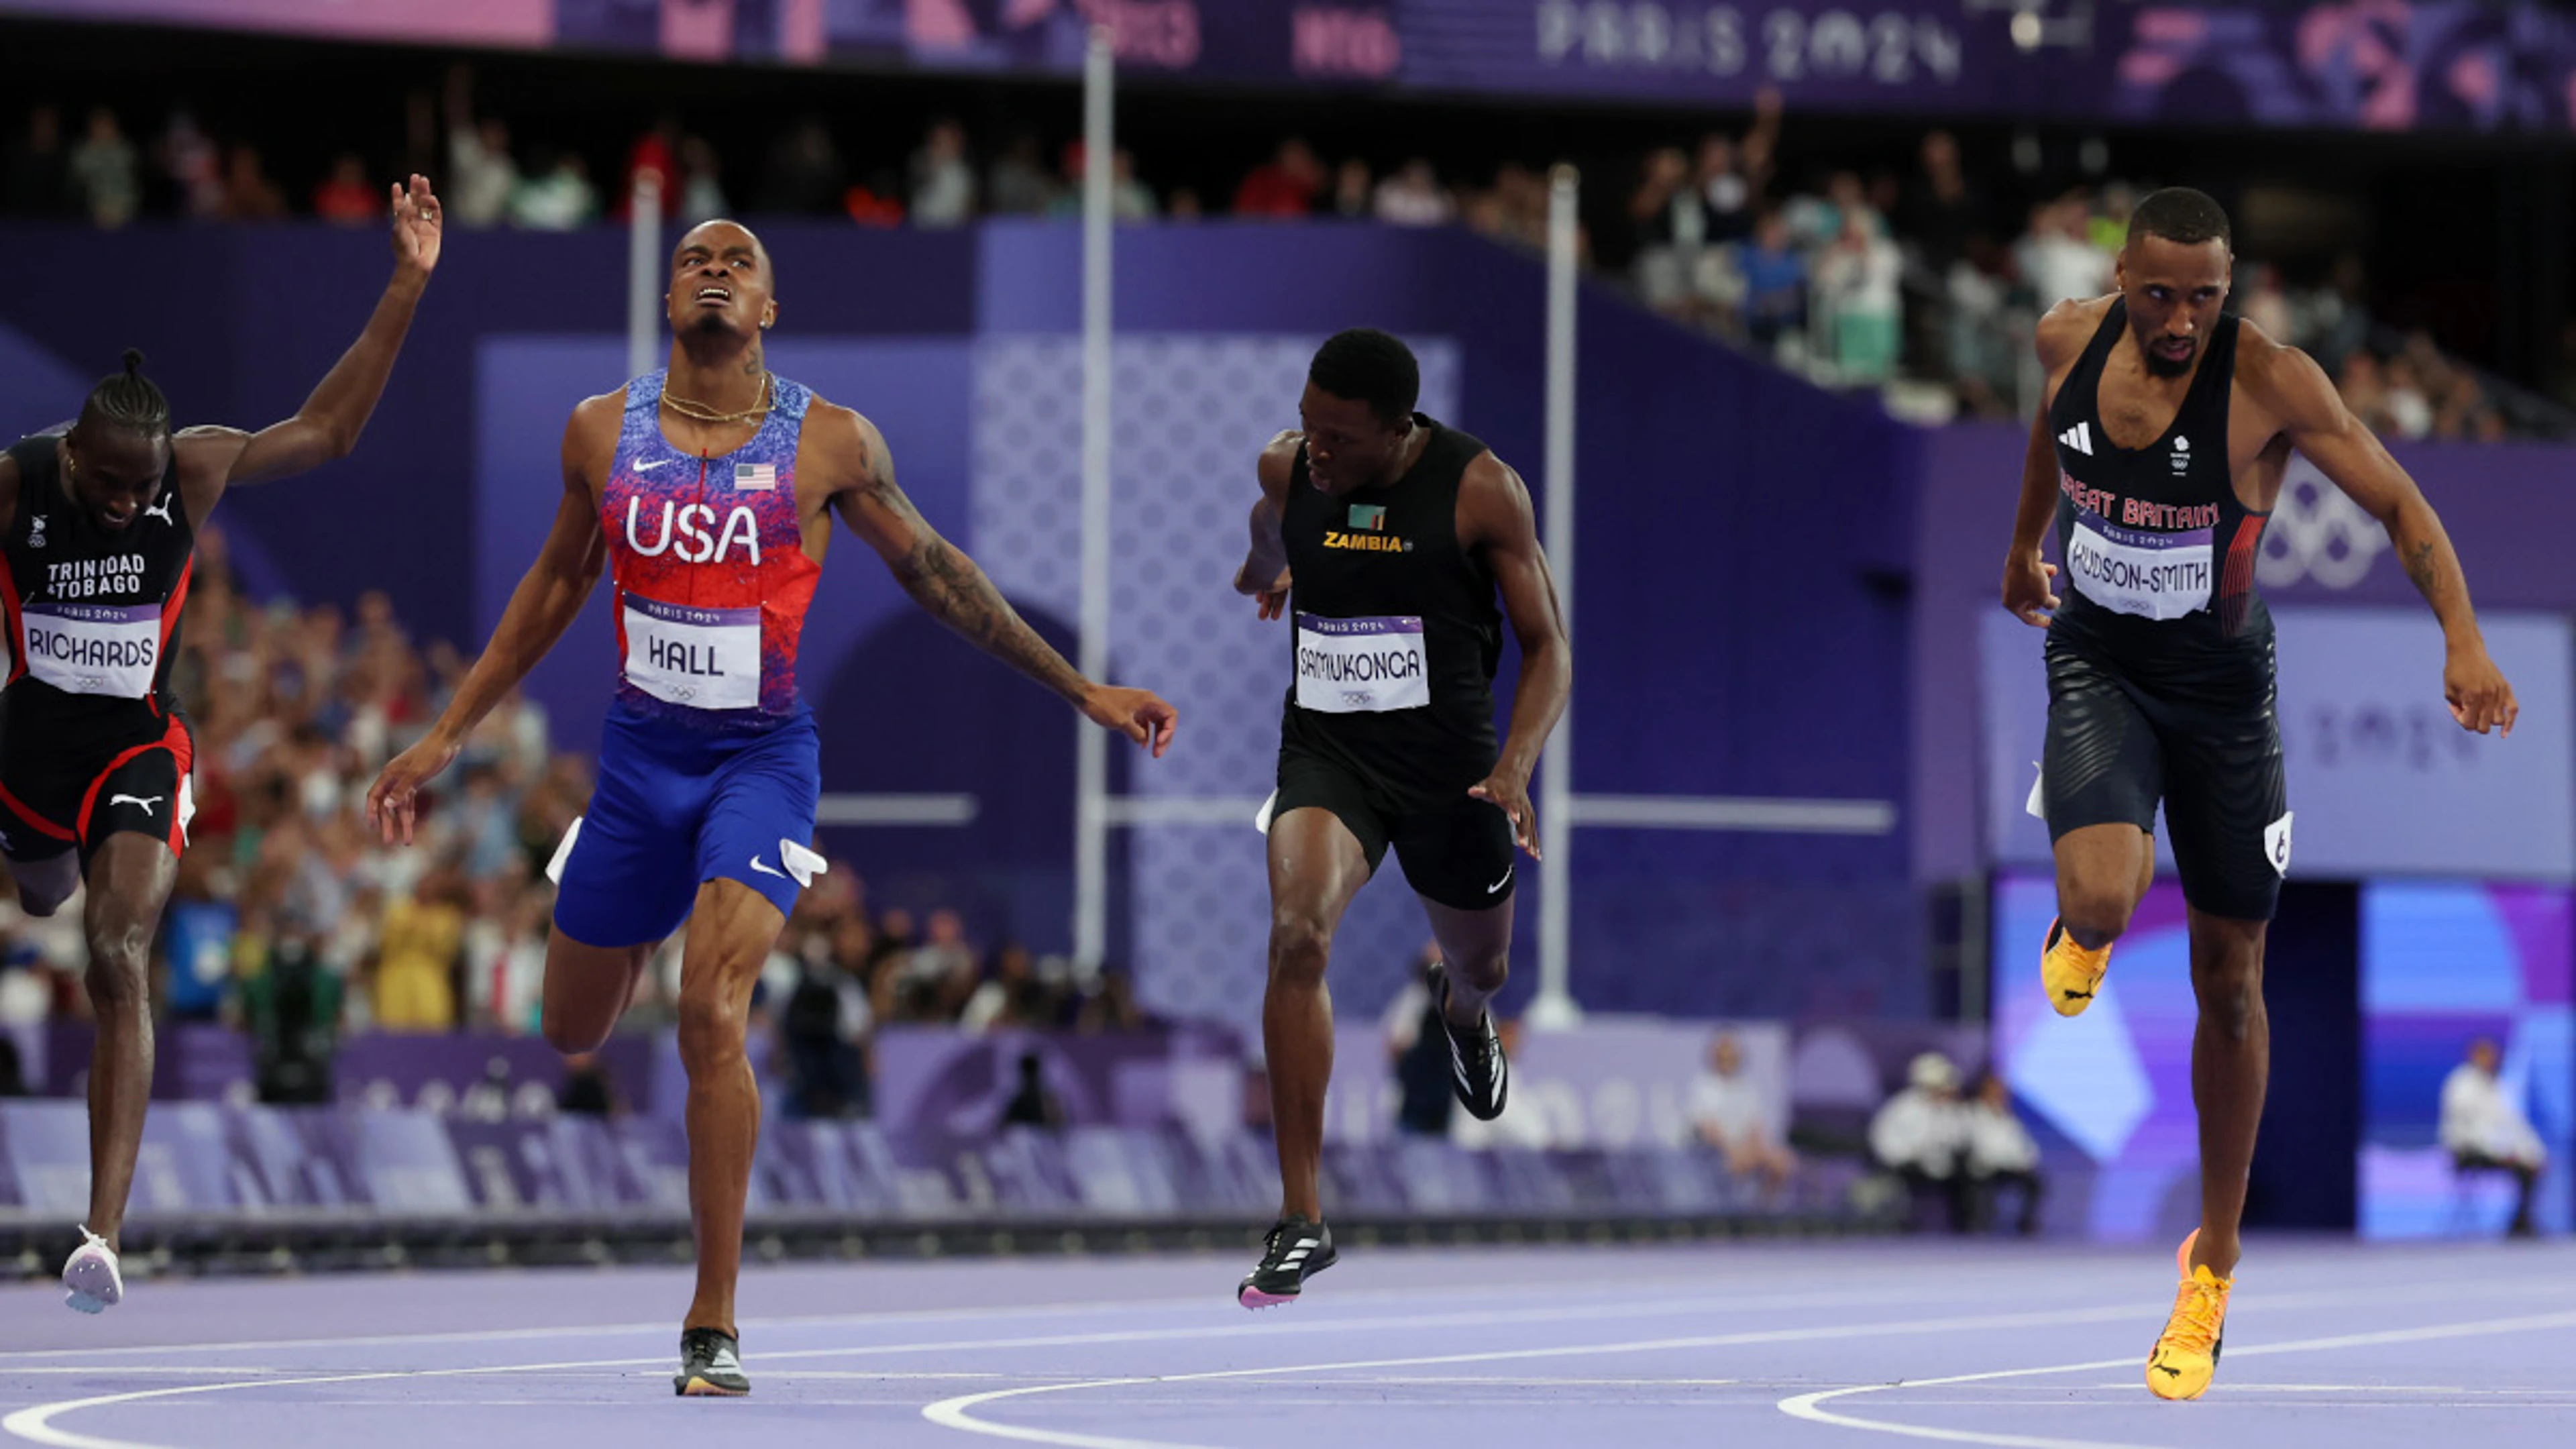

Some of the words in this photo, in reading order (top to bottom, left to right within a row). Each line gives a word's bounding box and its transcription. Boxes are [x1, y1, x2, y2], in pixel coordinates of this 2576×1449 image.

[1536, 2, 1746, 77] PARIS
[1762, 8, 1963, 84] 2024
[2123, 498, 2220, 529] BRITAIN
[626, 495, 761, 566] USA
[1322, 531, 1403, 552] ZAMBIA
[2139, 536, 2174, 547] 2024
[47, 554, 145, 582] TRINIDAD
[2072, 541, 2208, 593] HUDSON-SMITH
[57, 605, 91, 619] PARIS
[94, 609, 128, 621] 2024
[647, 603, 682, 619] PARIS
[686, 611, 720, 623] 2024
[1318, 621, 1349, 632] PARIS
[1352, 622, 1385, 632] 2024
[29, 628, 154, 667] RICHARDS
[649, 635, 724, 677] HALL
[1300, 647, 1420, 682] SAMUKONGA
